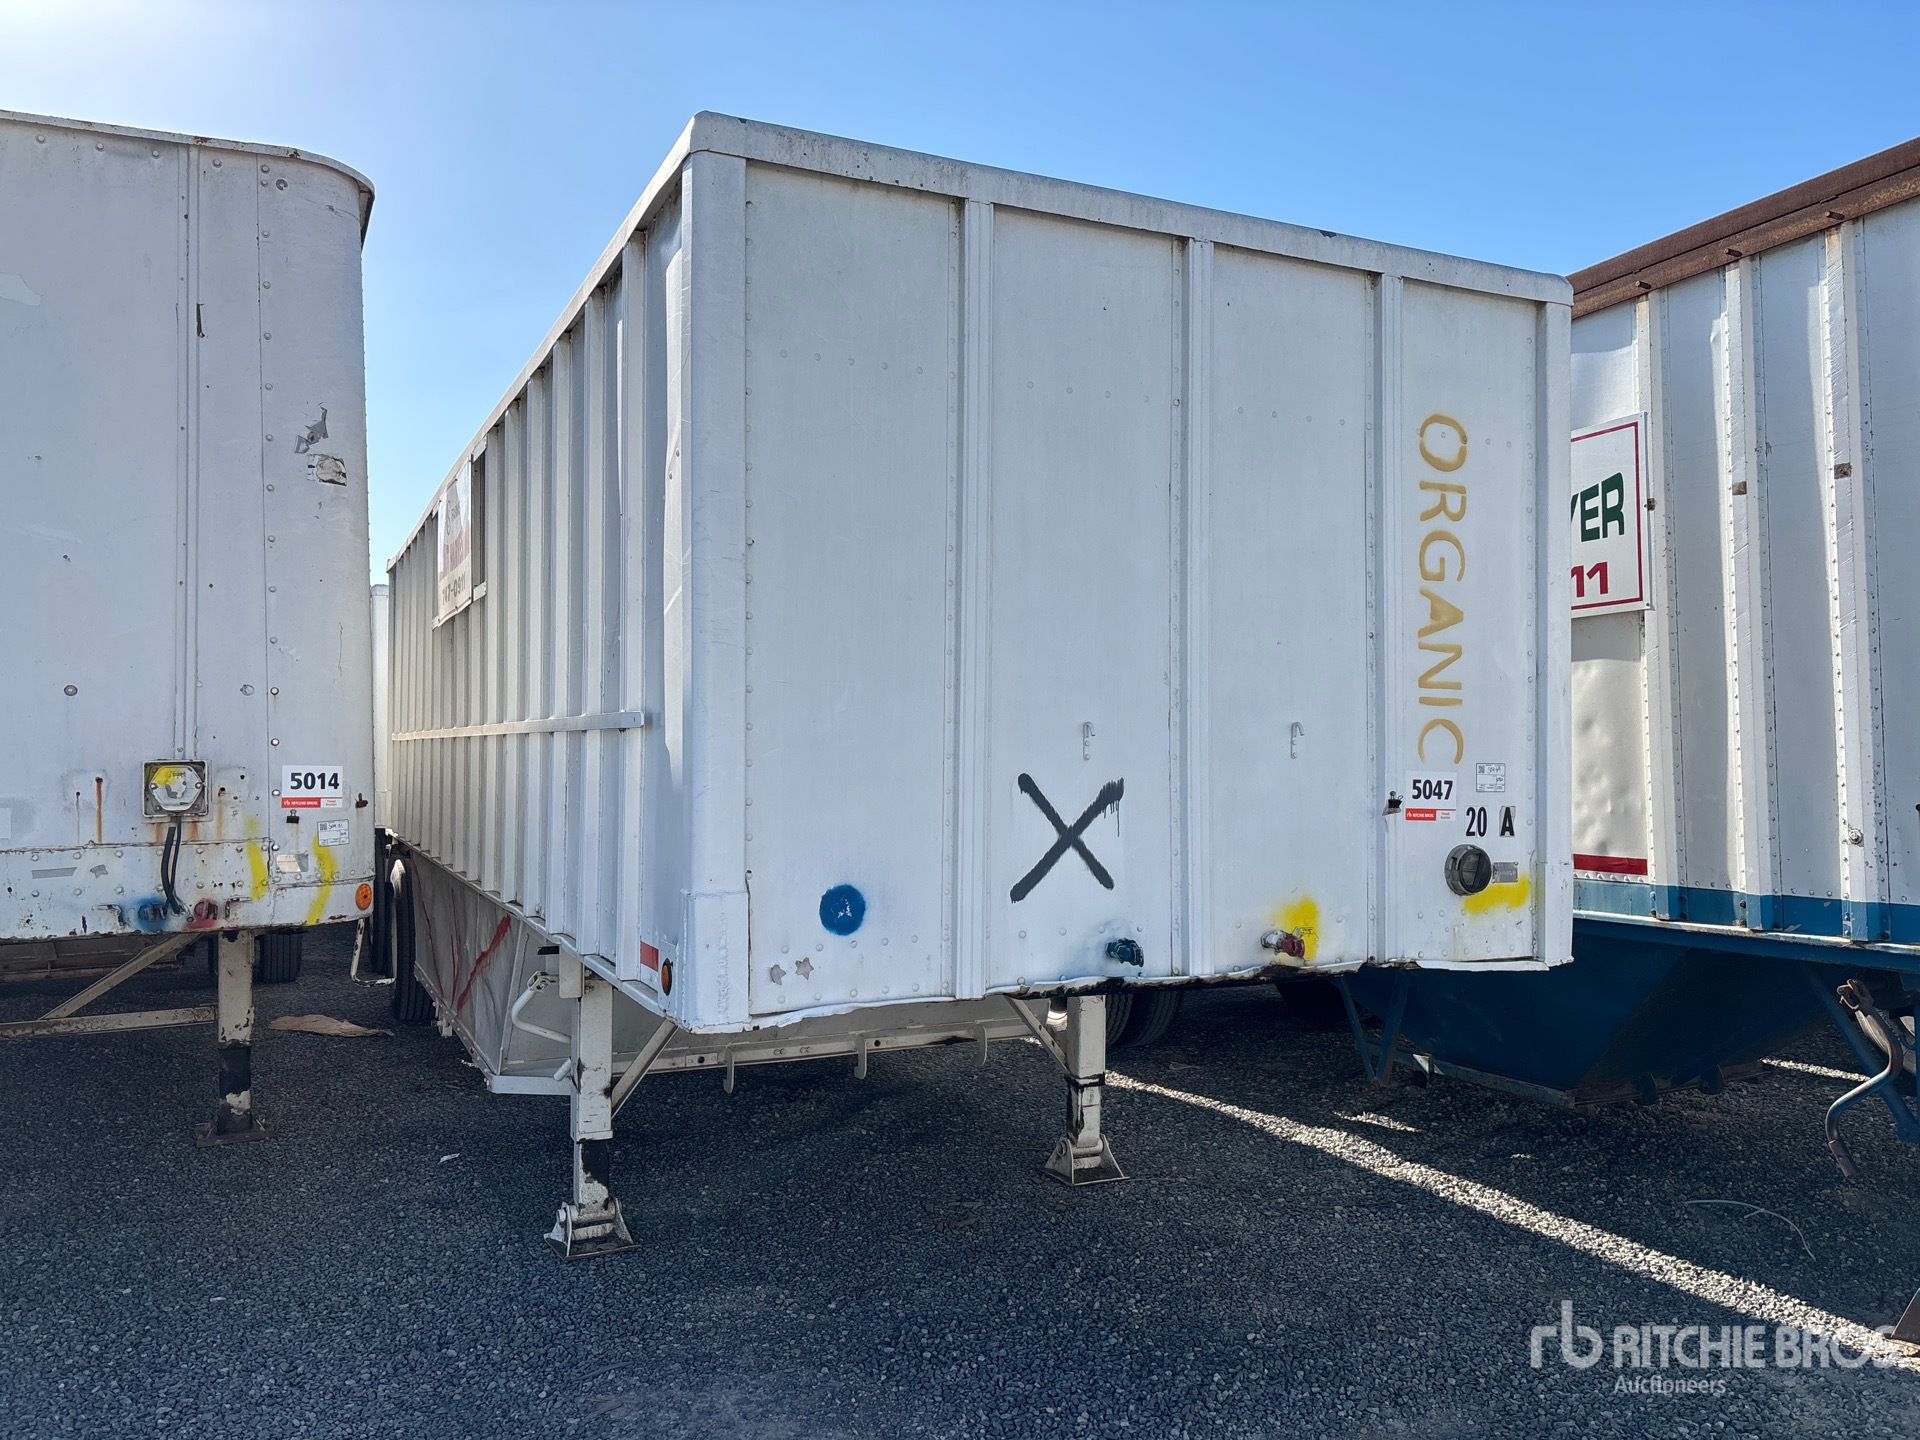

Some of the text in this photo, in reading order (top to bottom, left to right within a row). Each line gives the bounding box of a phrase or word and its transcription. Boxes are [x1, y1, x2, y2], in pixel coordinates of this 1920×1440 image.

[1418, 413, 1467, 764] ORGANIC
[290, 772, 340, 790] 5014
[1412, 779, 1454, 800] 5047
[1466, 806, 1515, 837] 20 A
